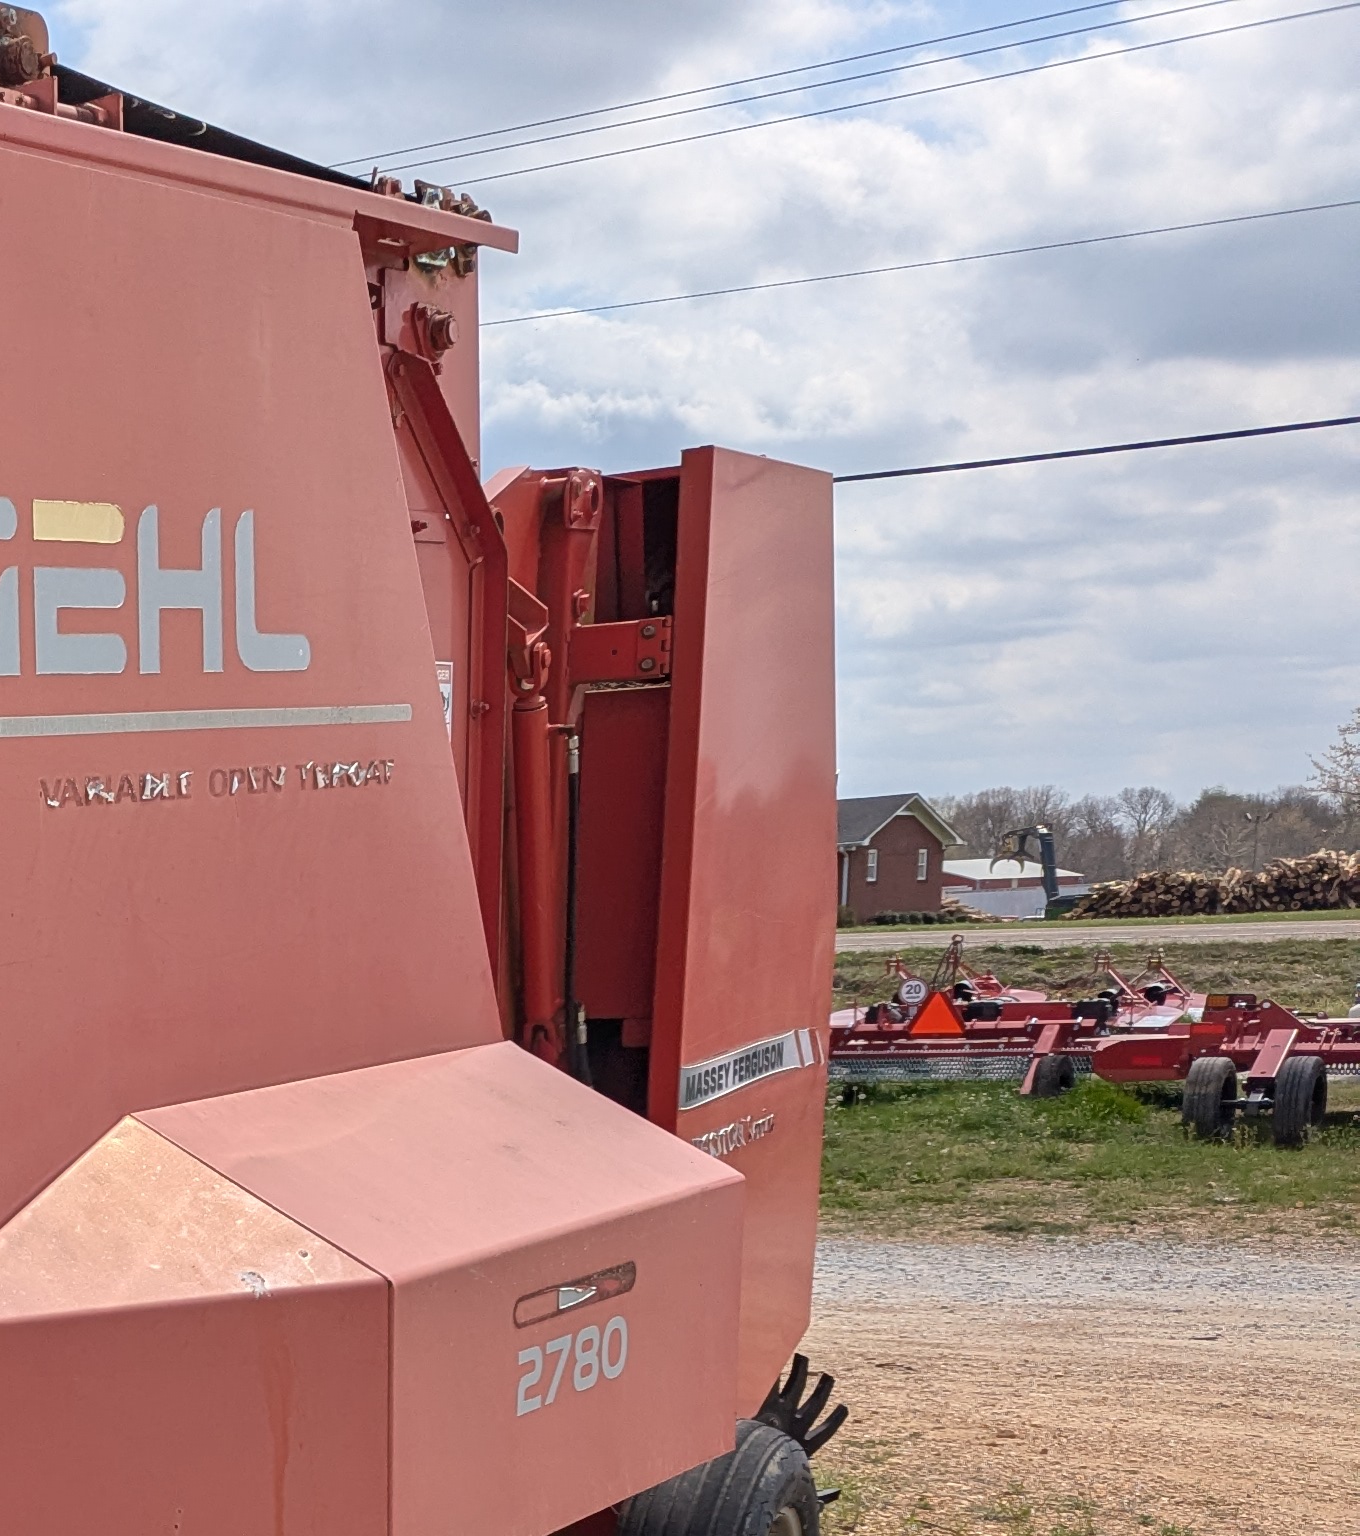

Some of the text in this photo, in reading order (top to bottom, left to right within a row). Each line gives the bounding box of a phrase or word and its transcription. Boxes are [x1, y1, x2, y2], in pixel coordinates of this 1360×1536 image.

[39, 759, 394, 809] VARIABLE OPEN THROAT
[905, 983, 922, 995] 20
[685, 1041, 785, 1103] MASSEY FERGUSON
[516, 1315, 628, 1417] 2780
